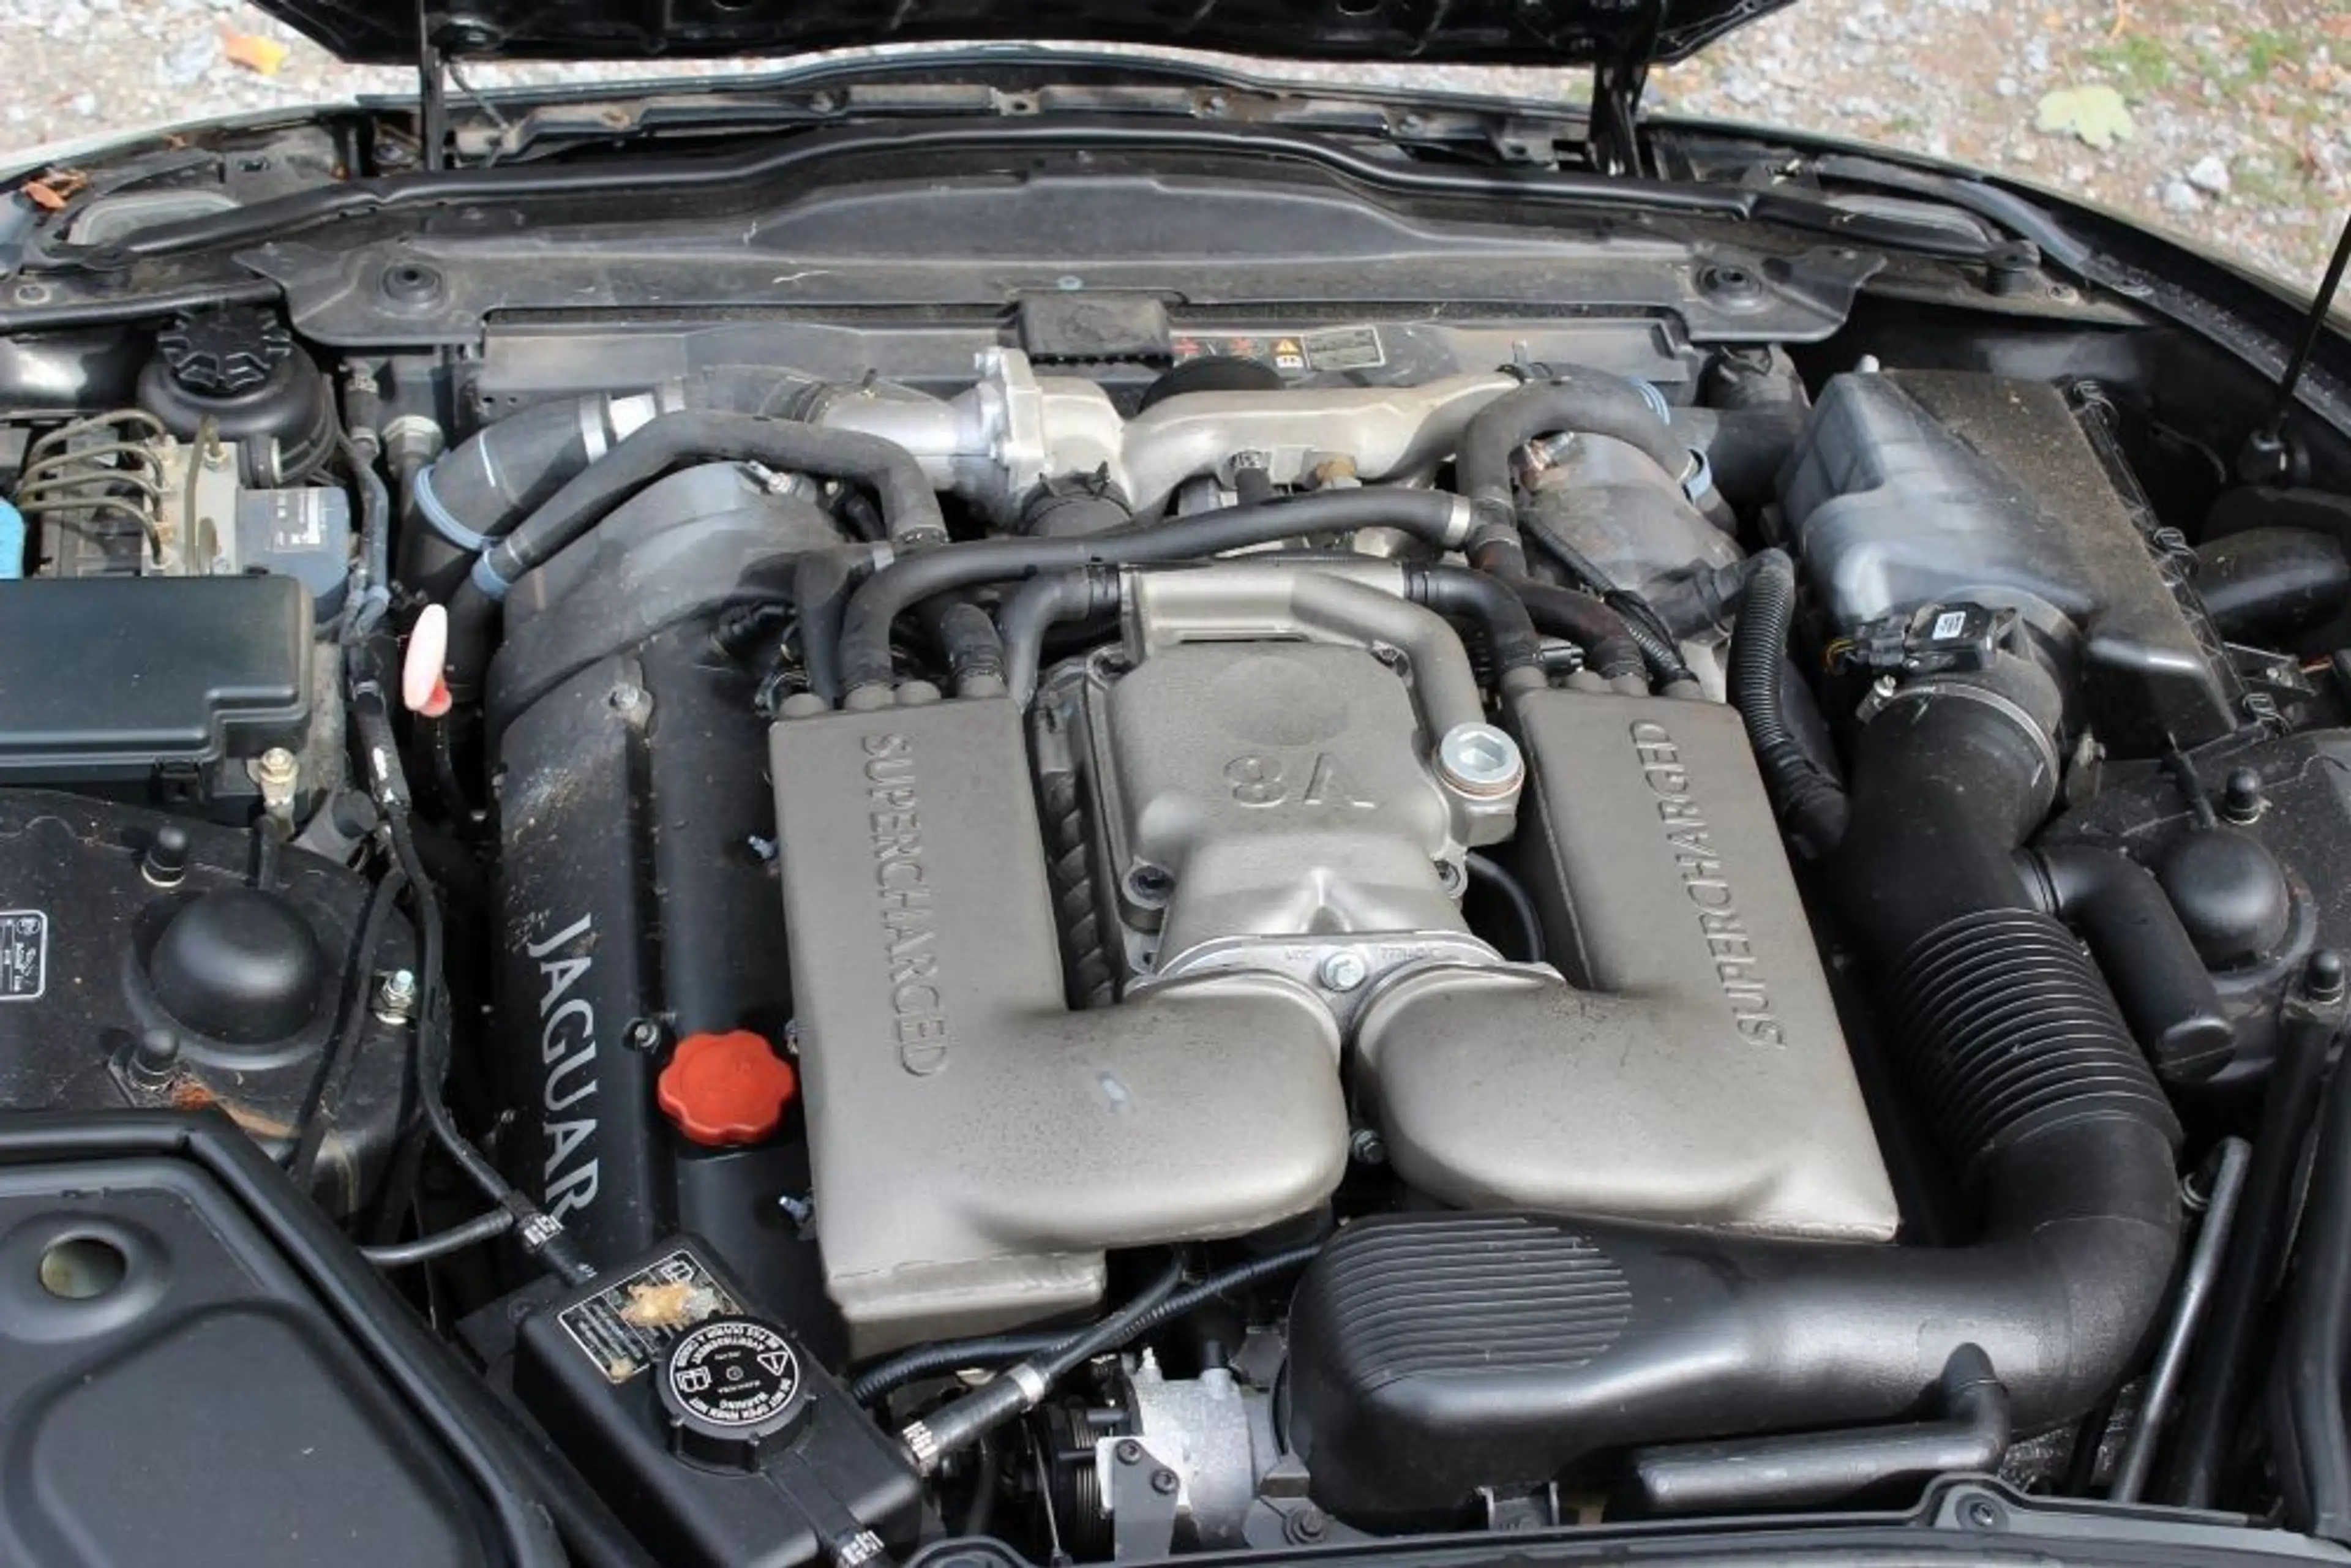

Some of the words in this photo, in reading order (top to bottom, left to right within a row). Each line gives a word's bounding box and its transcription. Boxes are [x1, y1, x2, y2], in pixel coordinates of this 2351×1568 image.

[1224, 753, 1376, 808] V8
[1628, 719, 1786, 1049] SUPERCHARGED
[861, 734, 950, 1078] SUPERCHARGED
[527, 913, 599, 1225] JAGUAR
[689, 1397, 708, 1413] HOT
[719, 1392, 769, 1409] WARNING
[769, 1391, 786, 1408] NOT
[708, 1408, 739, 1419] WHEN
[741, 1403, 770, 1419] OPEN
